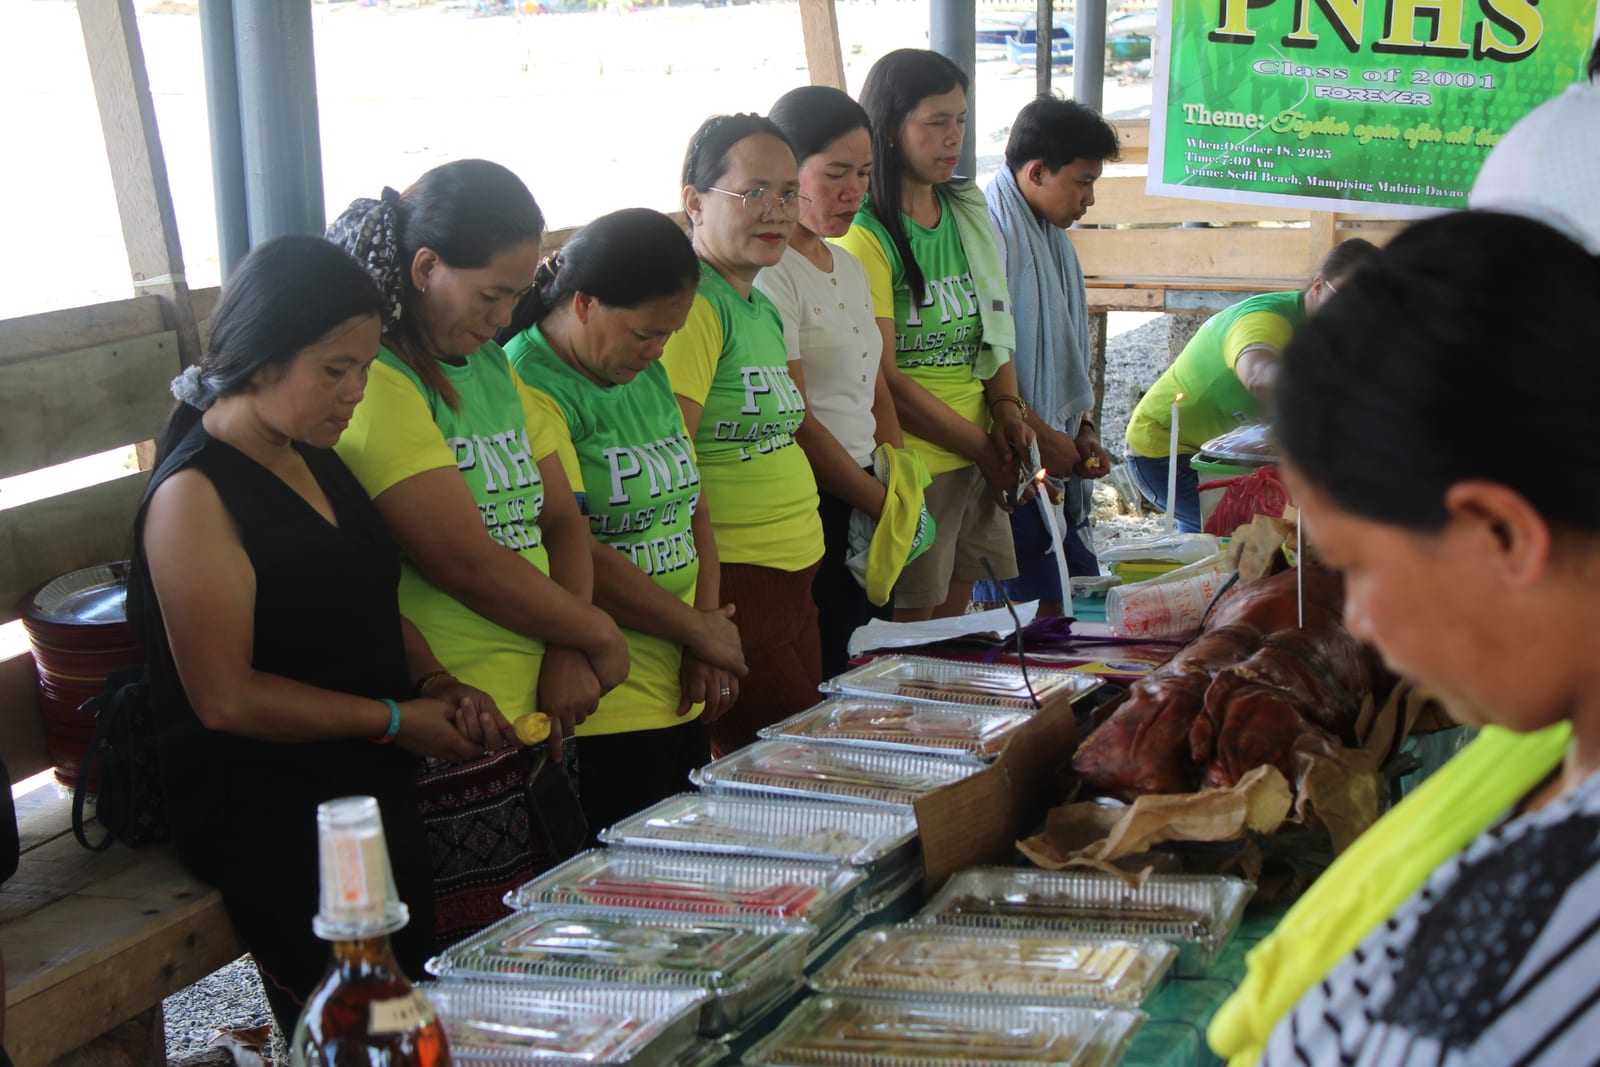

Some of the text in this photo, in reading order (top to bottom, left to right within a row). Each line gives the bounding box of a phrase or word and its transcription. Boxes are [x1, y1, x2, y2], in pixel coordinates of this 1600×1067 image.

[1253, 59, 1497, 91] Class of 2001
[1313, 84, 1433, 107] FOREVER
[1183, 103, 1266, 129] Theme:
[1271, 110, 1349, 141] Together
[1353, 124, 1400, 145] again
[1403, 122, 1443, 150] after
[1445, 125, 1474, 145] all
[1184, 151, 1275, 169] Time: 7:00 Am
[1298, 147, 1332, 160] 2025
[1184, 165, 1224, 178] Venue:
[1378, 181, 1421, 195] Mabini
[1425, 185, 1464, 198] Davao
[952, 324, 971, 345] OF
[661, 499, 682, 525] OF
